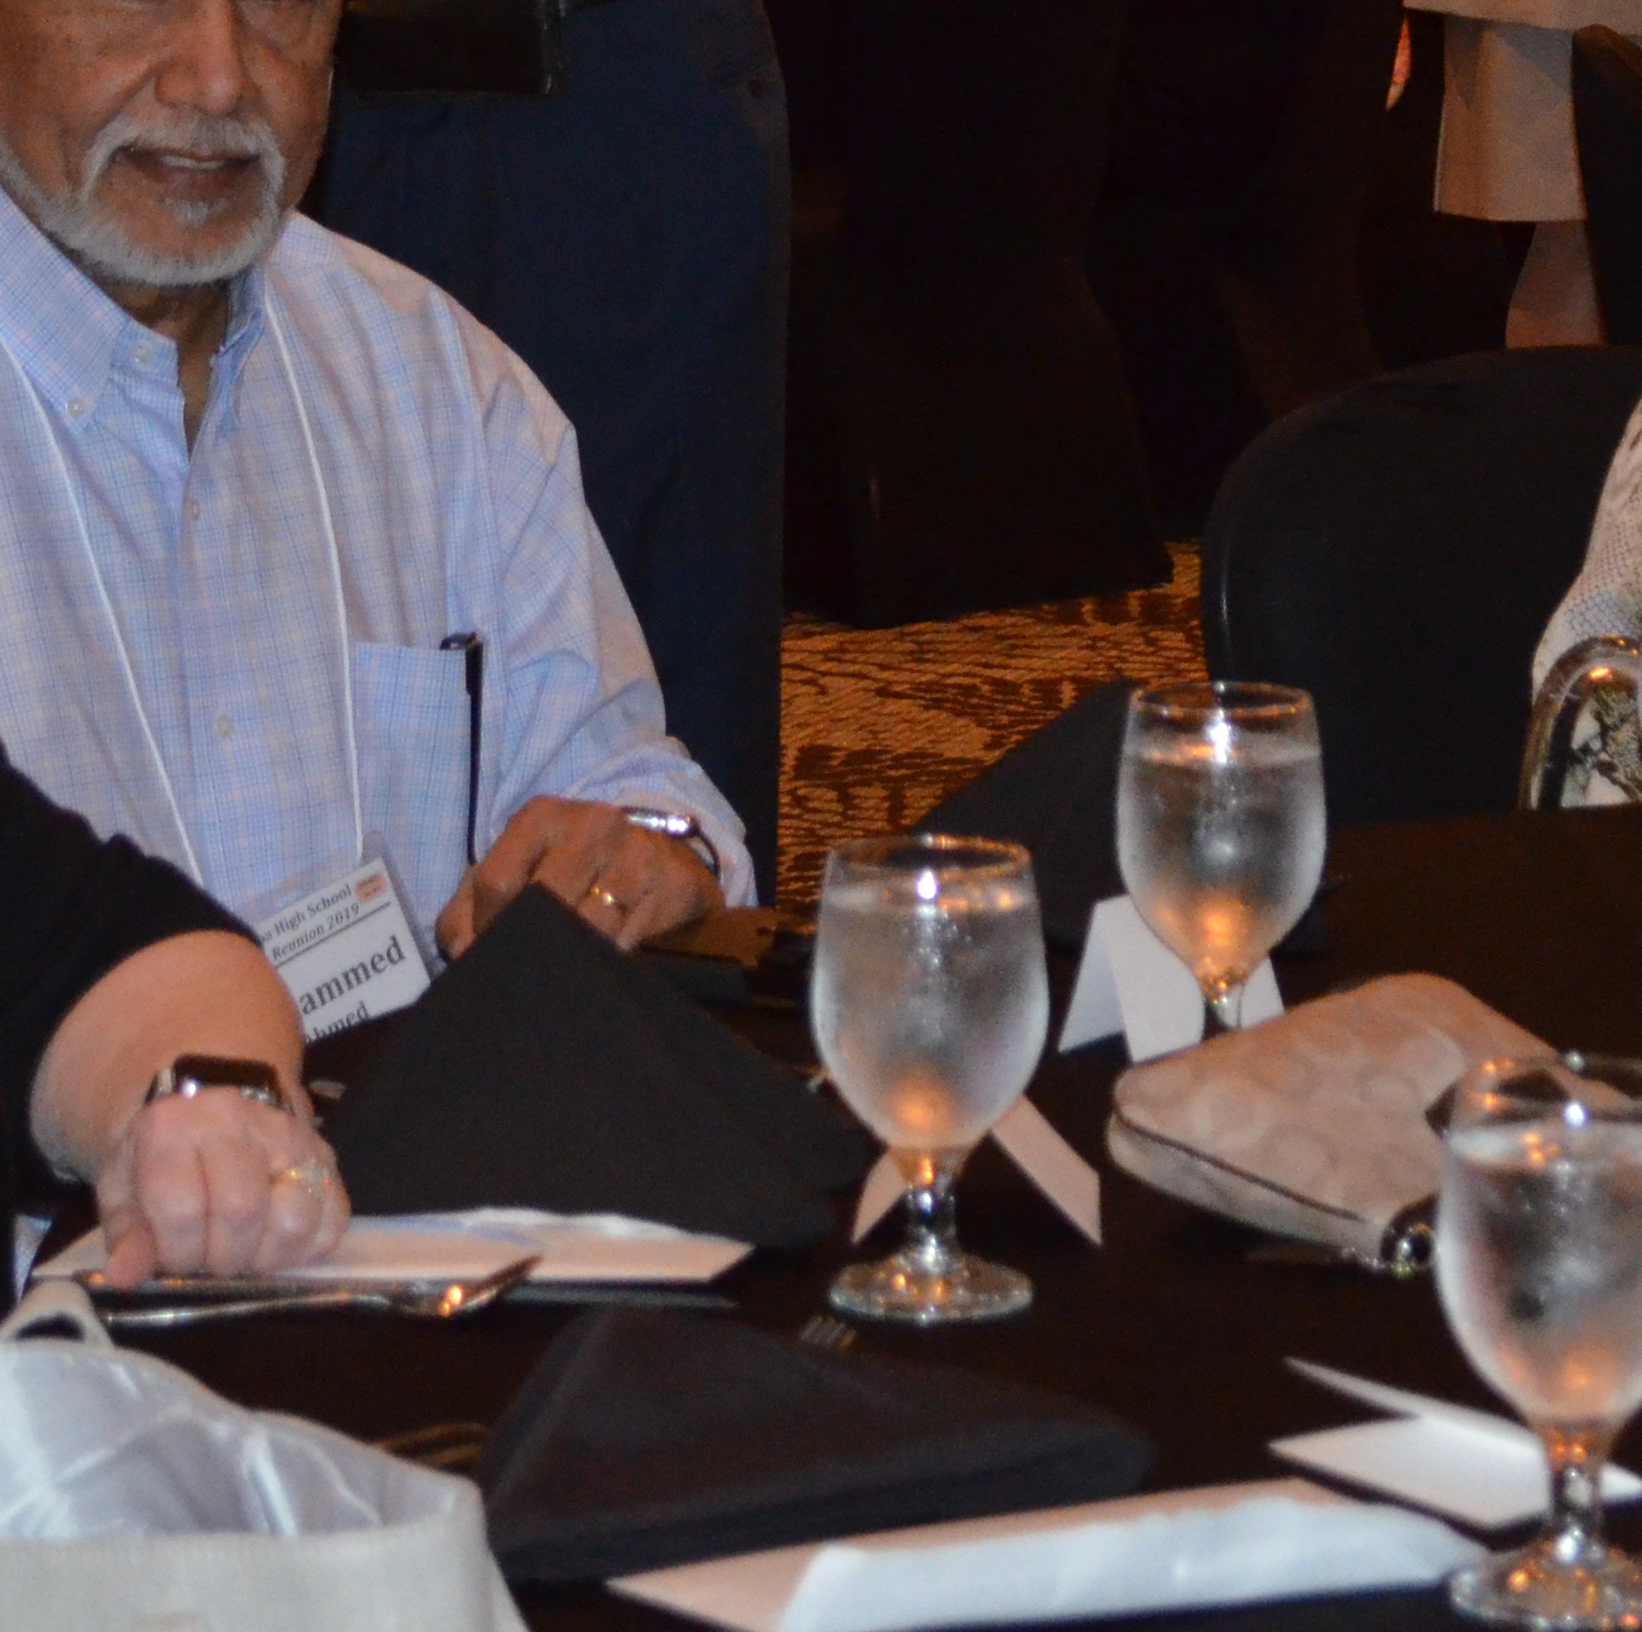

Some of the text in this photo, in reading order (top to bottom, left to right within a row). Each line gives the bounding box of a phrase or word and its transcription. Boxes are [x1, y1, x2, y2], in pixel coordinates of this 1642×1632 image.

[272, 902, 361, 961] Reunion 2019
[273, 910, 306, 937] High
[306, 884, 353, 918] School
